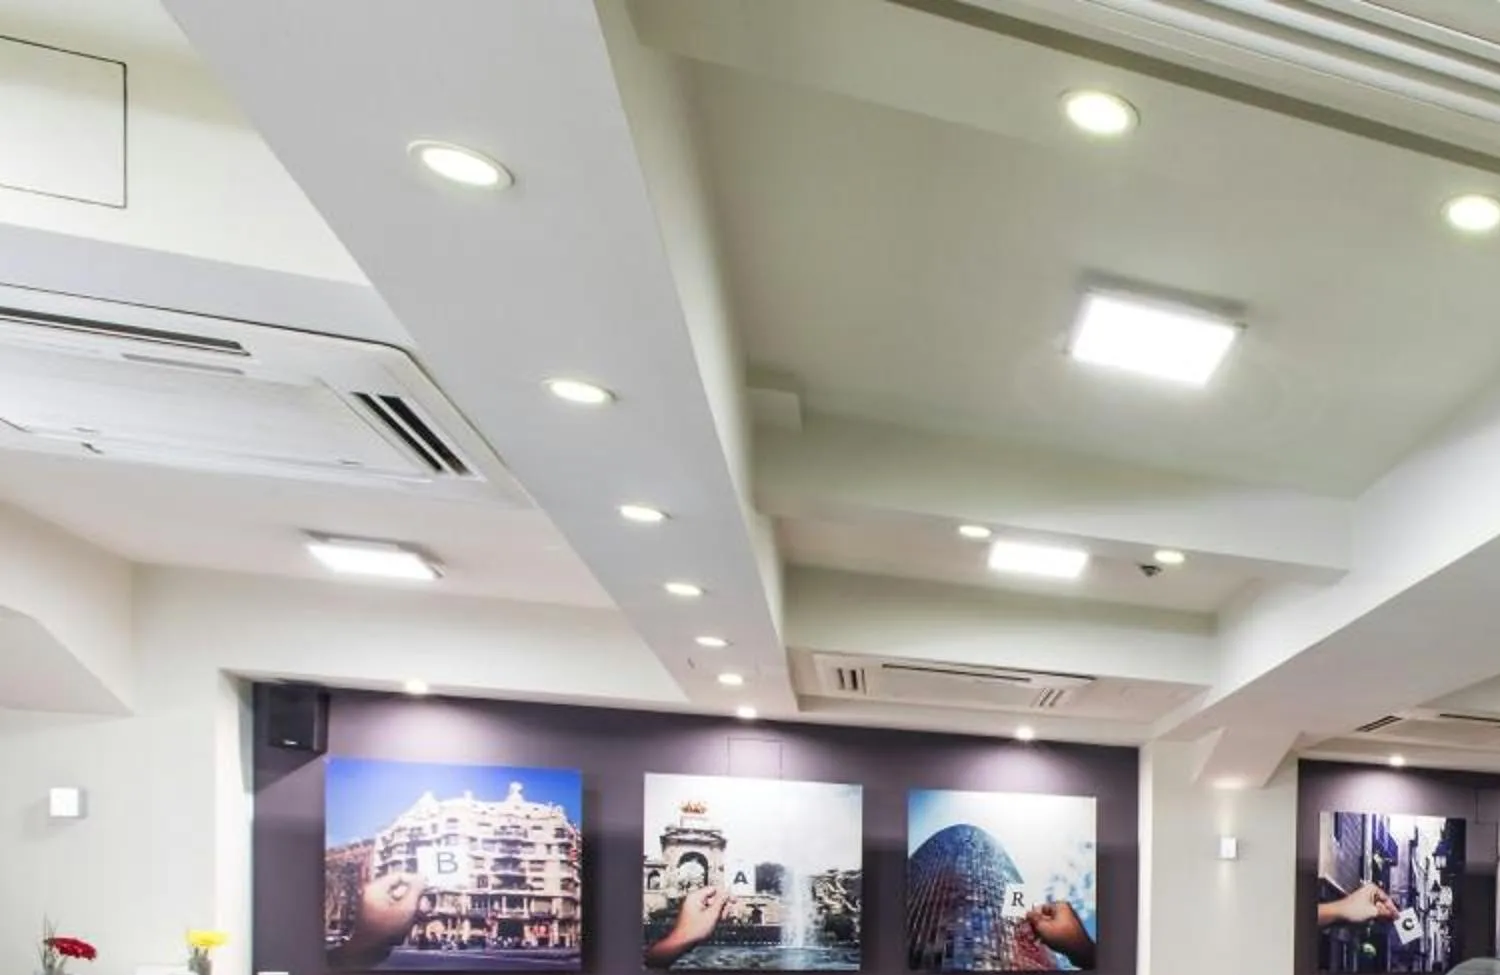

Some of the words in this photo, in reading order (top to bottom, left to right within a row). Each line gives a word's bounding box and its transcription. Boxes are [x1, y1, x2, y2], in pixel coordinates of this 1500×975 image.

[437, 852, 459, 874] B
[733, 871, 748, 884] A
[1011, 891, 1025, 908] R
[1402, 918, 1415, 931] C
